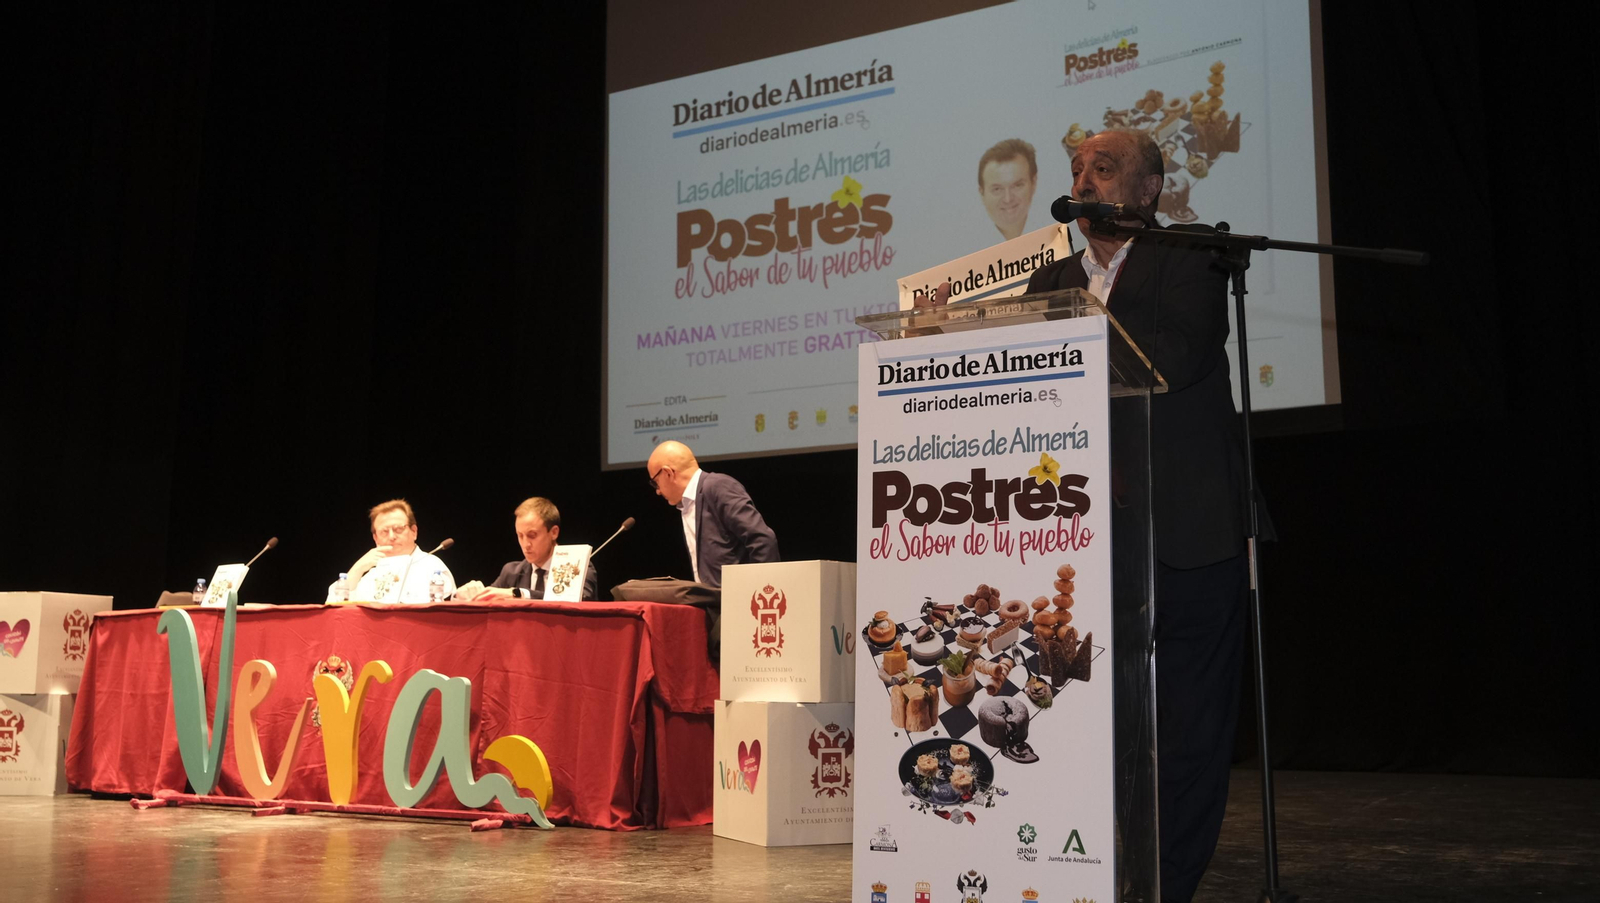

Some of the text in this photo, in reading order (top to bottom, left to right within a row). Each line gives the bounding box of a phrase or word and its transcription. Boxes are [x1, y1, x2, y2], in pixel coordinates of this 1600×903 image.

[1064, 43, 1139, 75] Postres
[672, 59, 894, 127] Diario de Almería
[700, 110, 866, 154] diariodealmeria.es
[677, 142, 891, 205] Las delicias de Almería
[676, 194, 894, 269] Postres
[674, 232, 896, 299] el Sabor de tu pueblo
[912, 244, 1055, 302] Diaio de Almería
[637, 324, 716, 350] MAÑANA
[721, 315, 799, 339] VIERNES
[804, 311, 828, 328] EN
[833, 307, 857, 325] TU
[686, 329, 881, 368] TOTALMENTE GRATIS
[878, 343, 1084, 385] Diario de Almería
[634, 411, 718, 430] Diario de Almería
[664, 395, 688, 407] EDITA
[903, 388, 1058, 413] diariodealmeria.es
[873, 422, 1089, 464] Las delicias de Almería
[872, 468, 1091, 528] Postres
[870, 512, 1094, 565] el Sabor de tu pueblo
[830, 622, 856, 656] Ve
[157, 591, 492, 812] Vera
[719, 759, 747, 791] Vera
[783, 817, 843, 825] AYUNTAMIENTO
[801, 806, 854, 814] EXCELENTÍSIM
[1017, 846, 1038, 857] gusto
[1023, 853, 1038, 862] Sur
[1073, 857, 1102, 865] Andalucía
